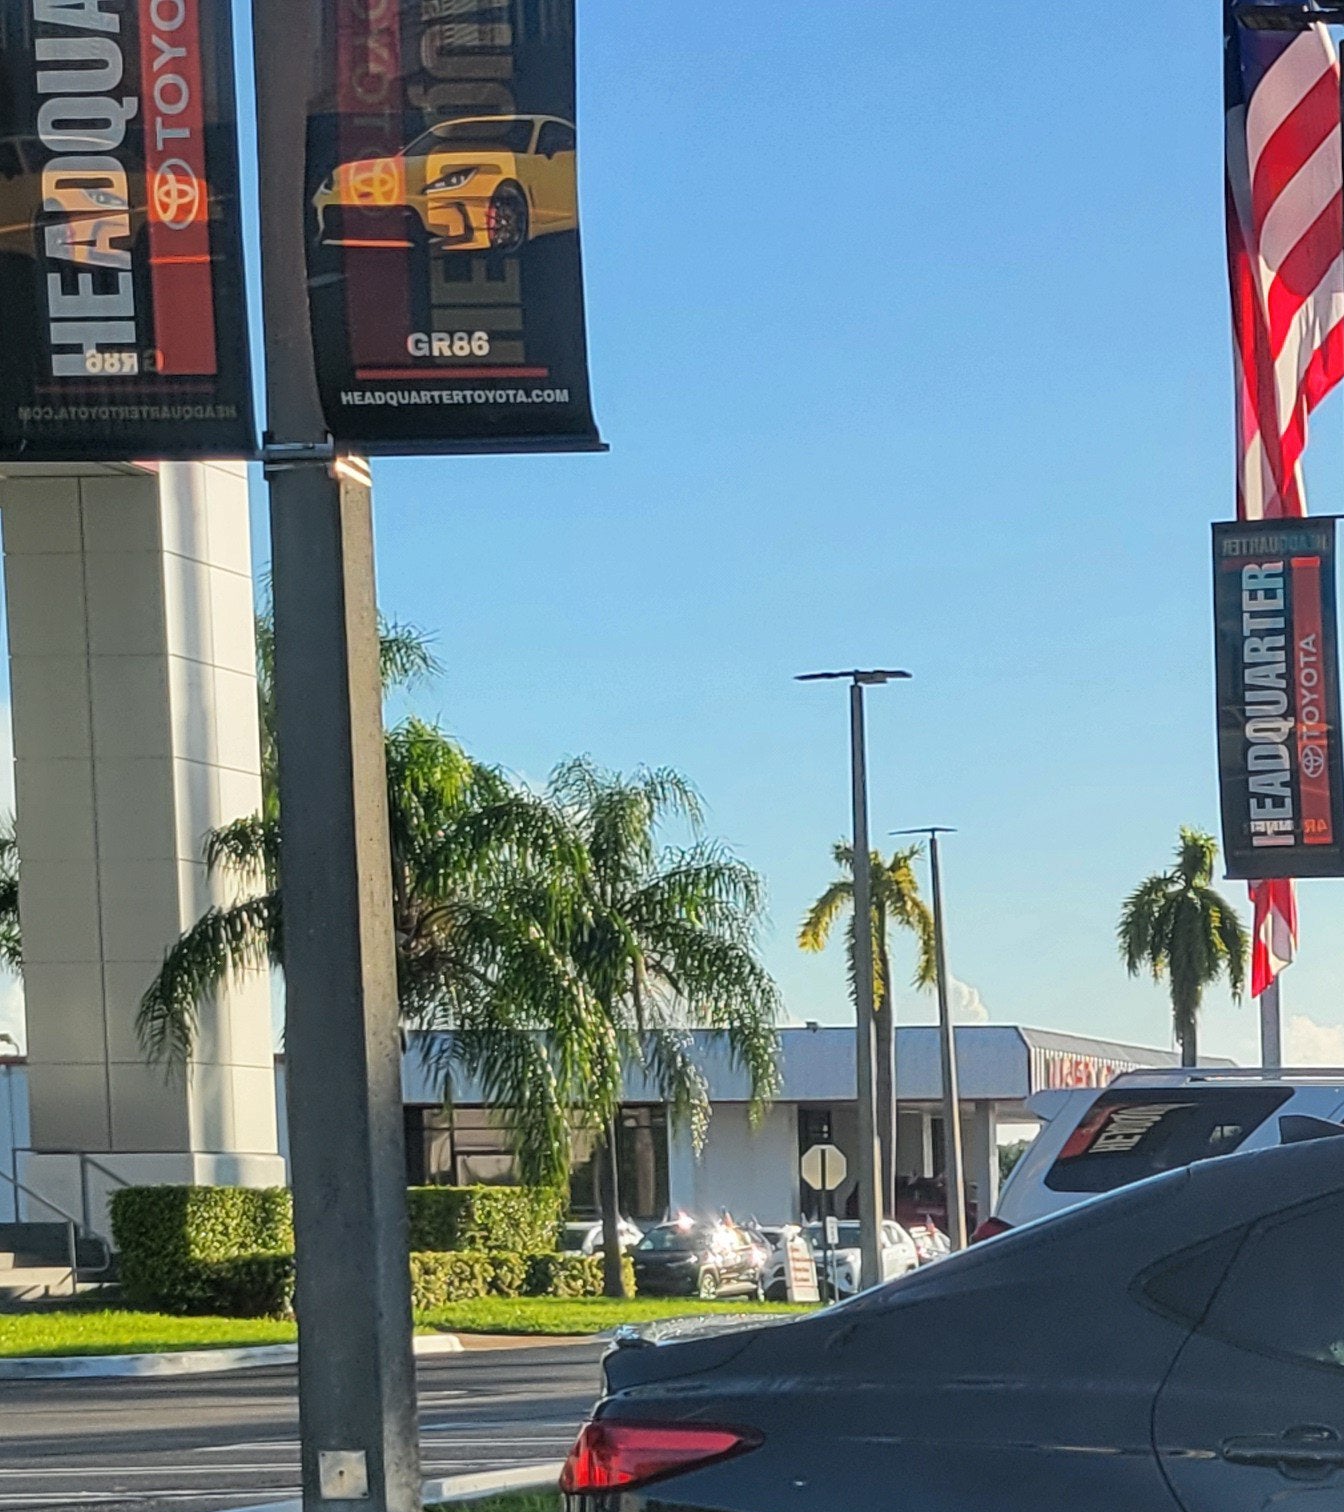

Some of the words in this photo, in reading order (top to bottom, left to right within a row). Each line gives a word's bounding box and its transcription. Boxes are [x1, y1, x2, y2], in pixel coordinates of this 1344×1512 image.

[150, 0, 191, 152] TOYO
[340, 389, 570, 407] HEADQUARTERTOYOTA.COM
[407, 331, 490, 358] GR86
[1241, 560, 1297, 847] HEADQUARTER
[1300, 632, 1320, 740] TOYOTA
